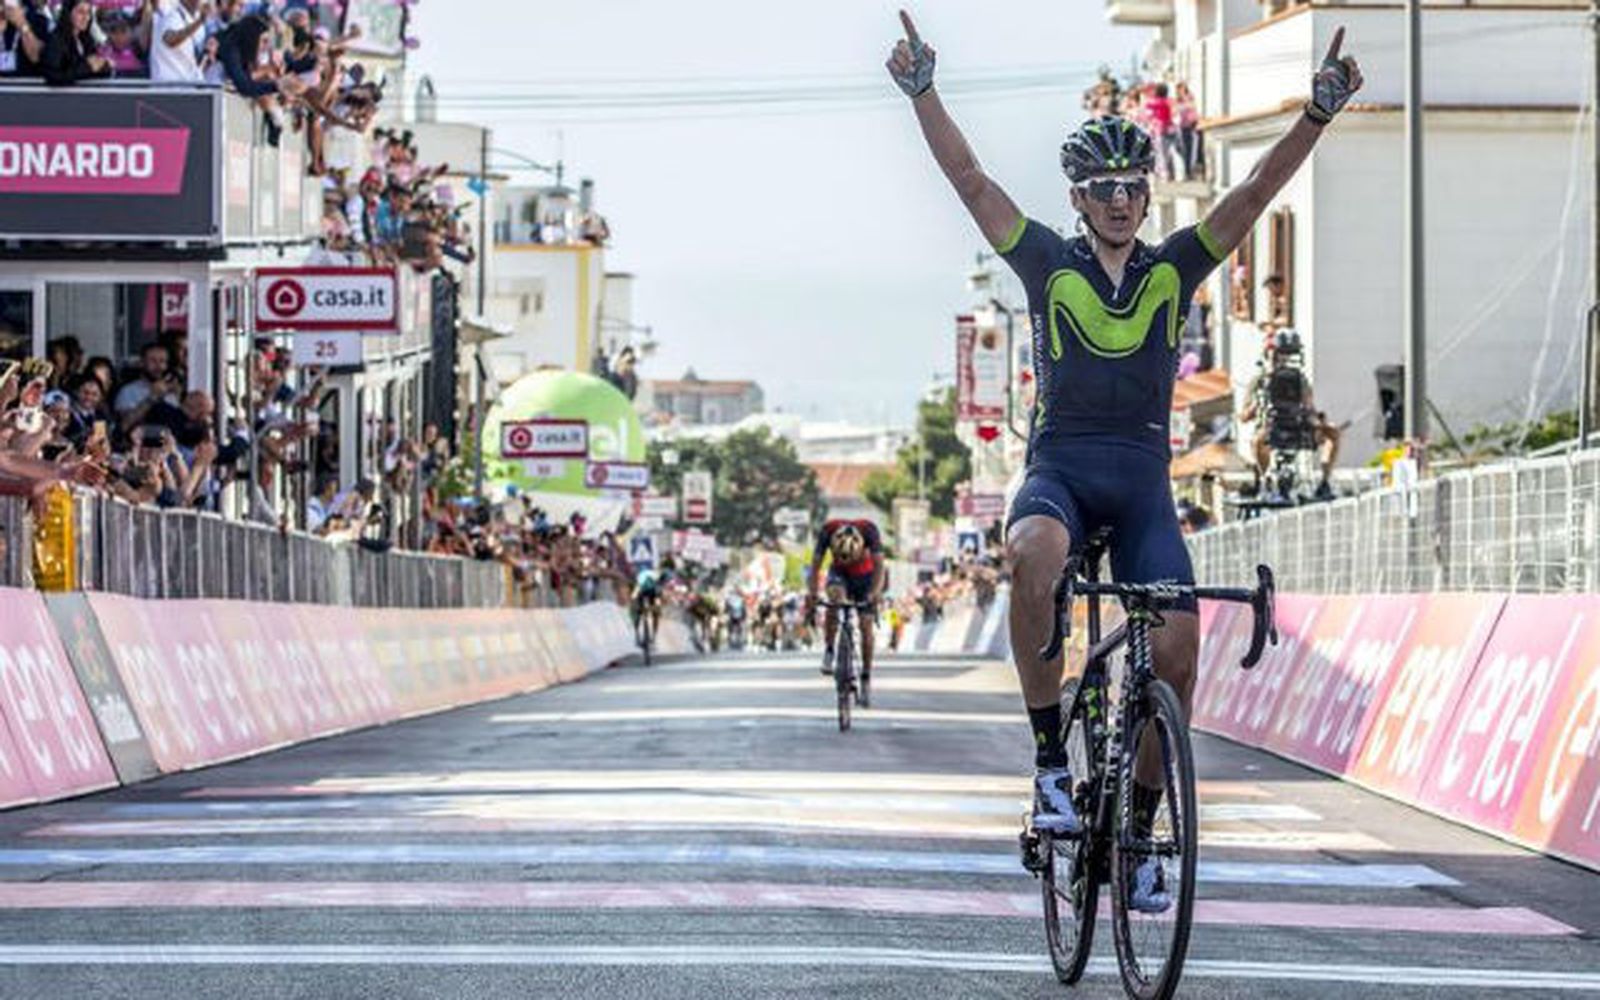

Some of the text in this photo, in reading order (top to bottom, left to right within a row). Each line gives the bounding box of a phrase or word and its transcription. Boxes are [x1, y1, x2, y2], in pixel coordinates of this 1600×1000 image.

[0, 142, 153, 177] ONARDO
[313, 286, 385, 307] casa.it
[314, 341, 338, 357] 25
[1366, 602, 1490, 776] enel
[1438, 611, 1584, 808] enel
